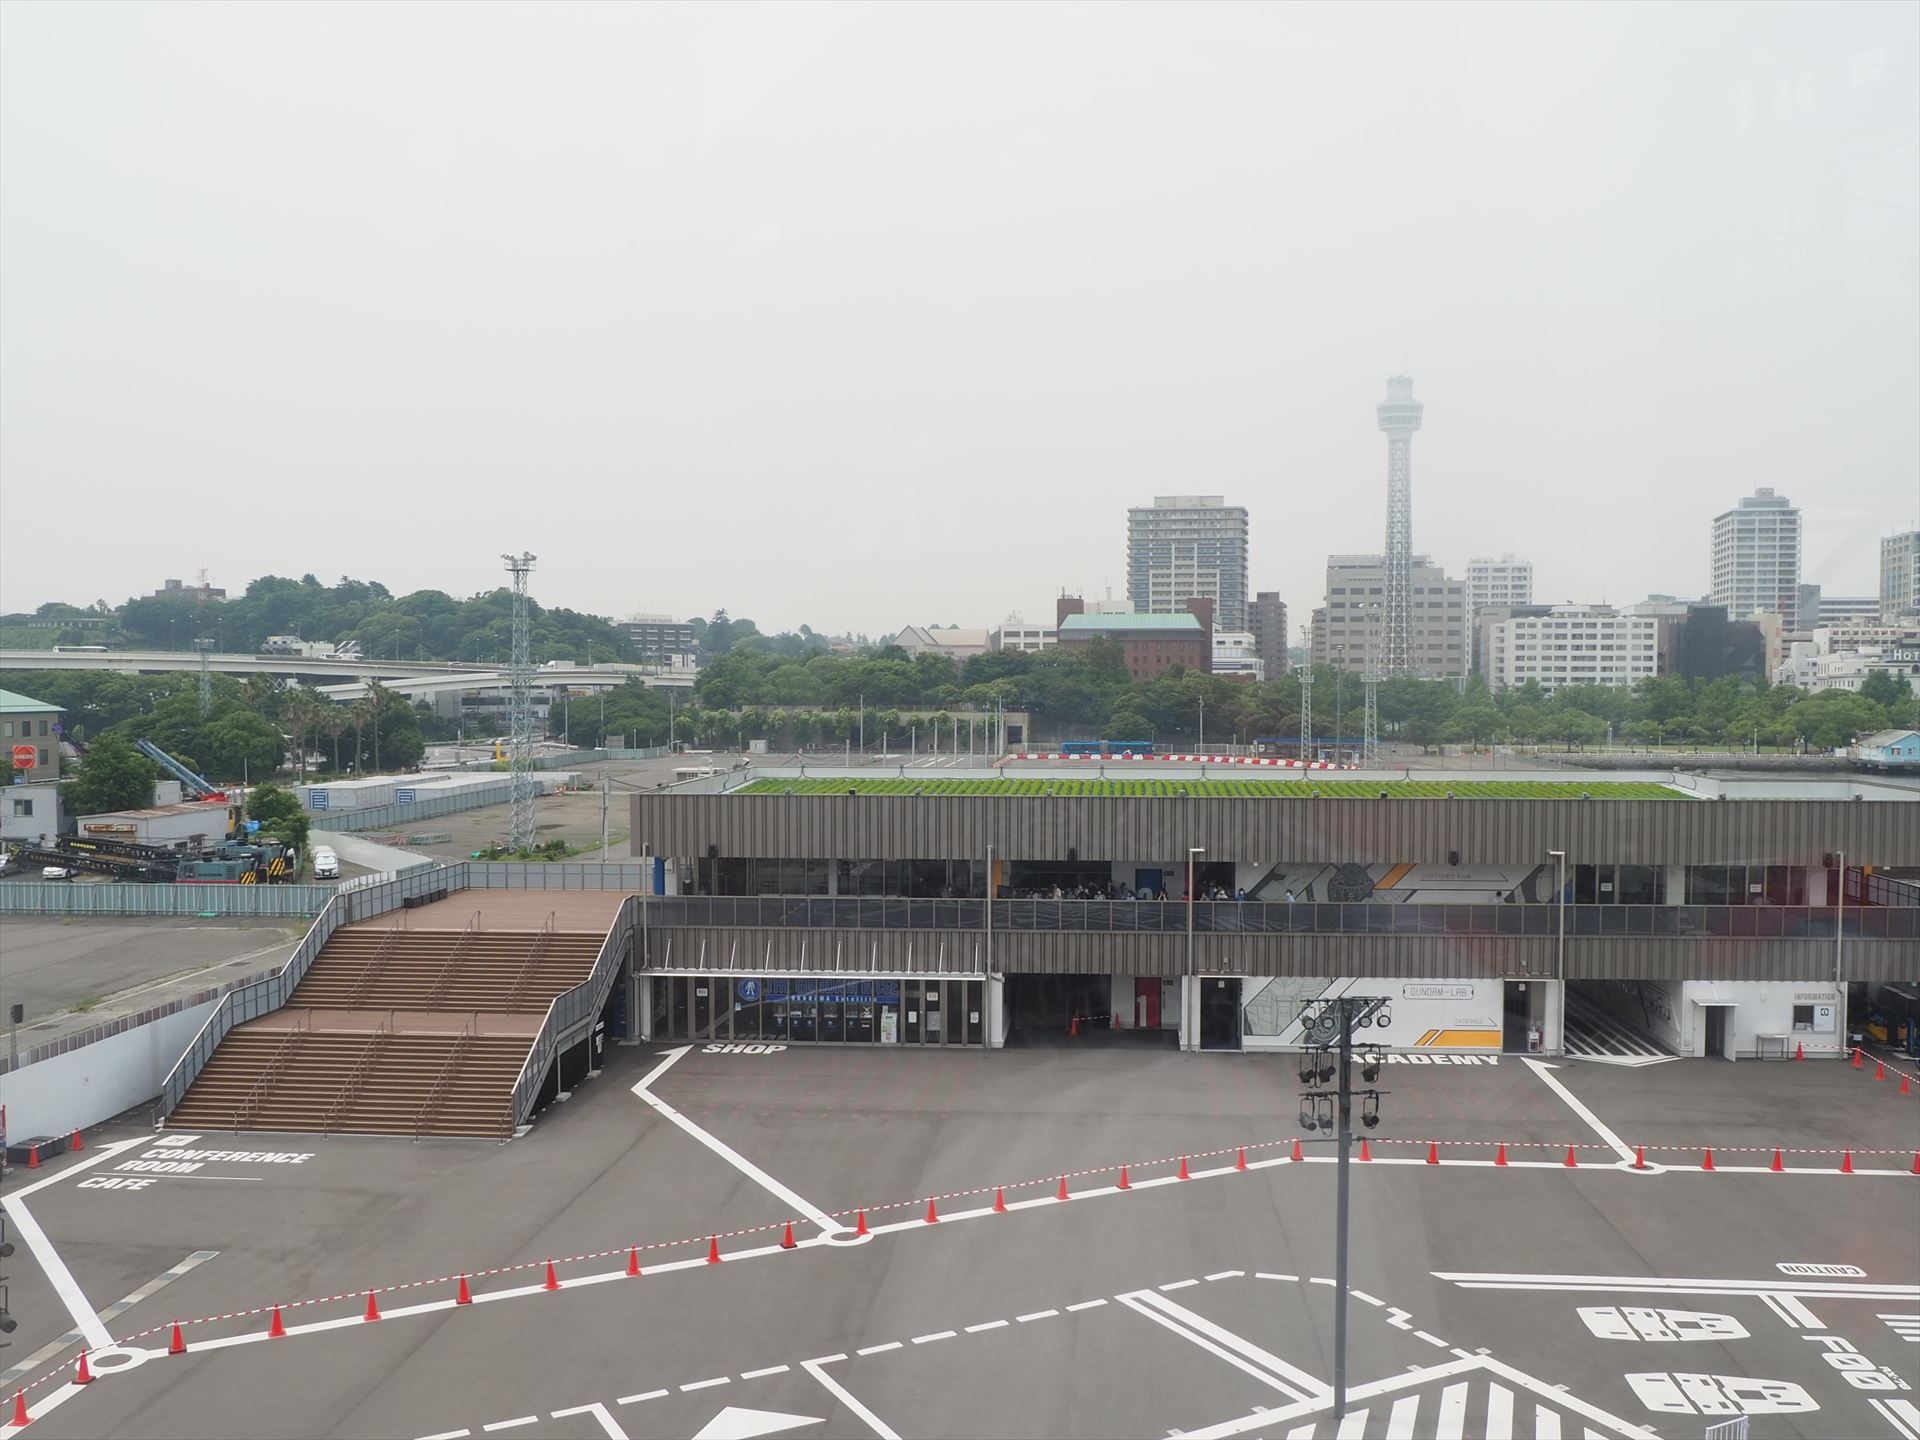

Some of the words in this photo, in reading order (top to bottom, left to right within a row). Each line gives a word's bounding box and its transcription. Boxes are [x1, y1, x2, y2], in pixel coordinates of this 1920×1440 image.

[1410, 987, 1468, 997] GUNDAM-LAB
[1794, 992, 1836, 1001] INFORMATION
[701, 1043, 788, 1054] SHOP
[140, 1149, 316, 1164] CONFERENCE
[113, 1160, 206, 1173] ROOM
[77, 1177, 158, 1190] CAFE
[1781, 1265, 1860, 1275] CAUTION
